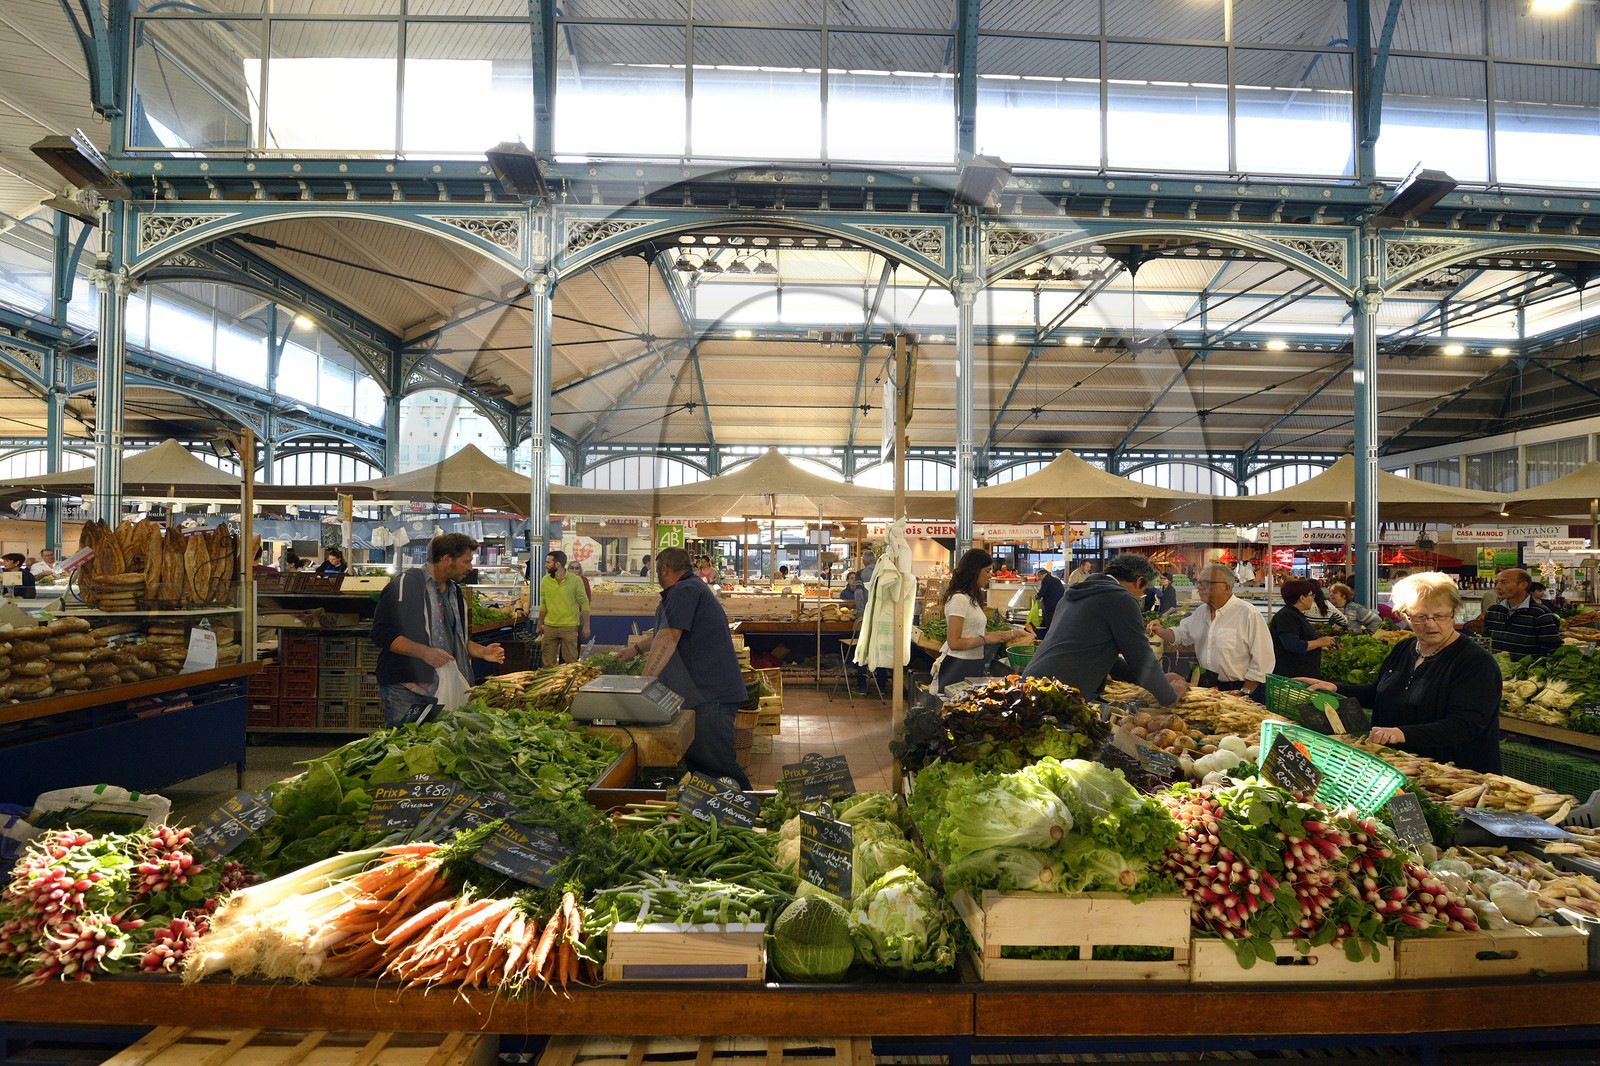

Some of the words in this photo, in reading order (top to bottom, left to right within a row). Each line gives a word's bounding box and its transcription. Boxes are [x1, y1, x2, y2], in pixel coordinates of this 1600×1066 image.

[1507, 526, 1561, 536] FONTANGY
[659, 532, 681, 549] AB
[784, 768, 802, 779] Prix
[690, 775, 711, 792] Prix
[374, 787, 399, 799] Prix
[498, 822, 521, 842] Prix
